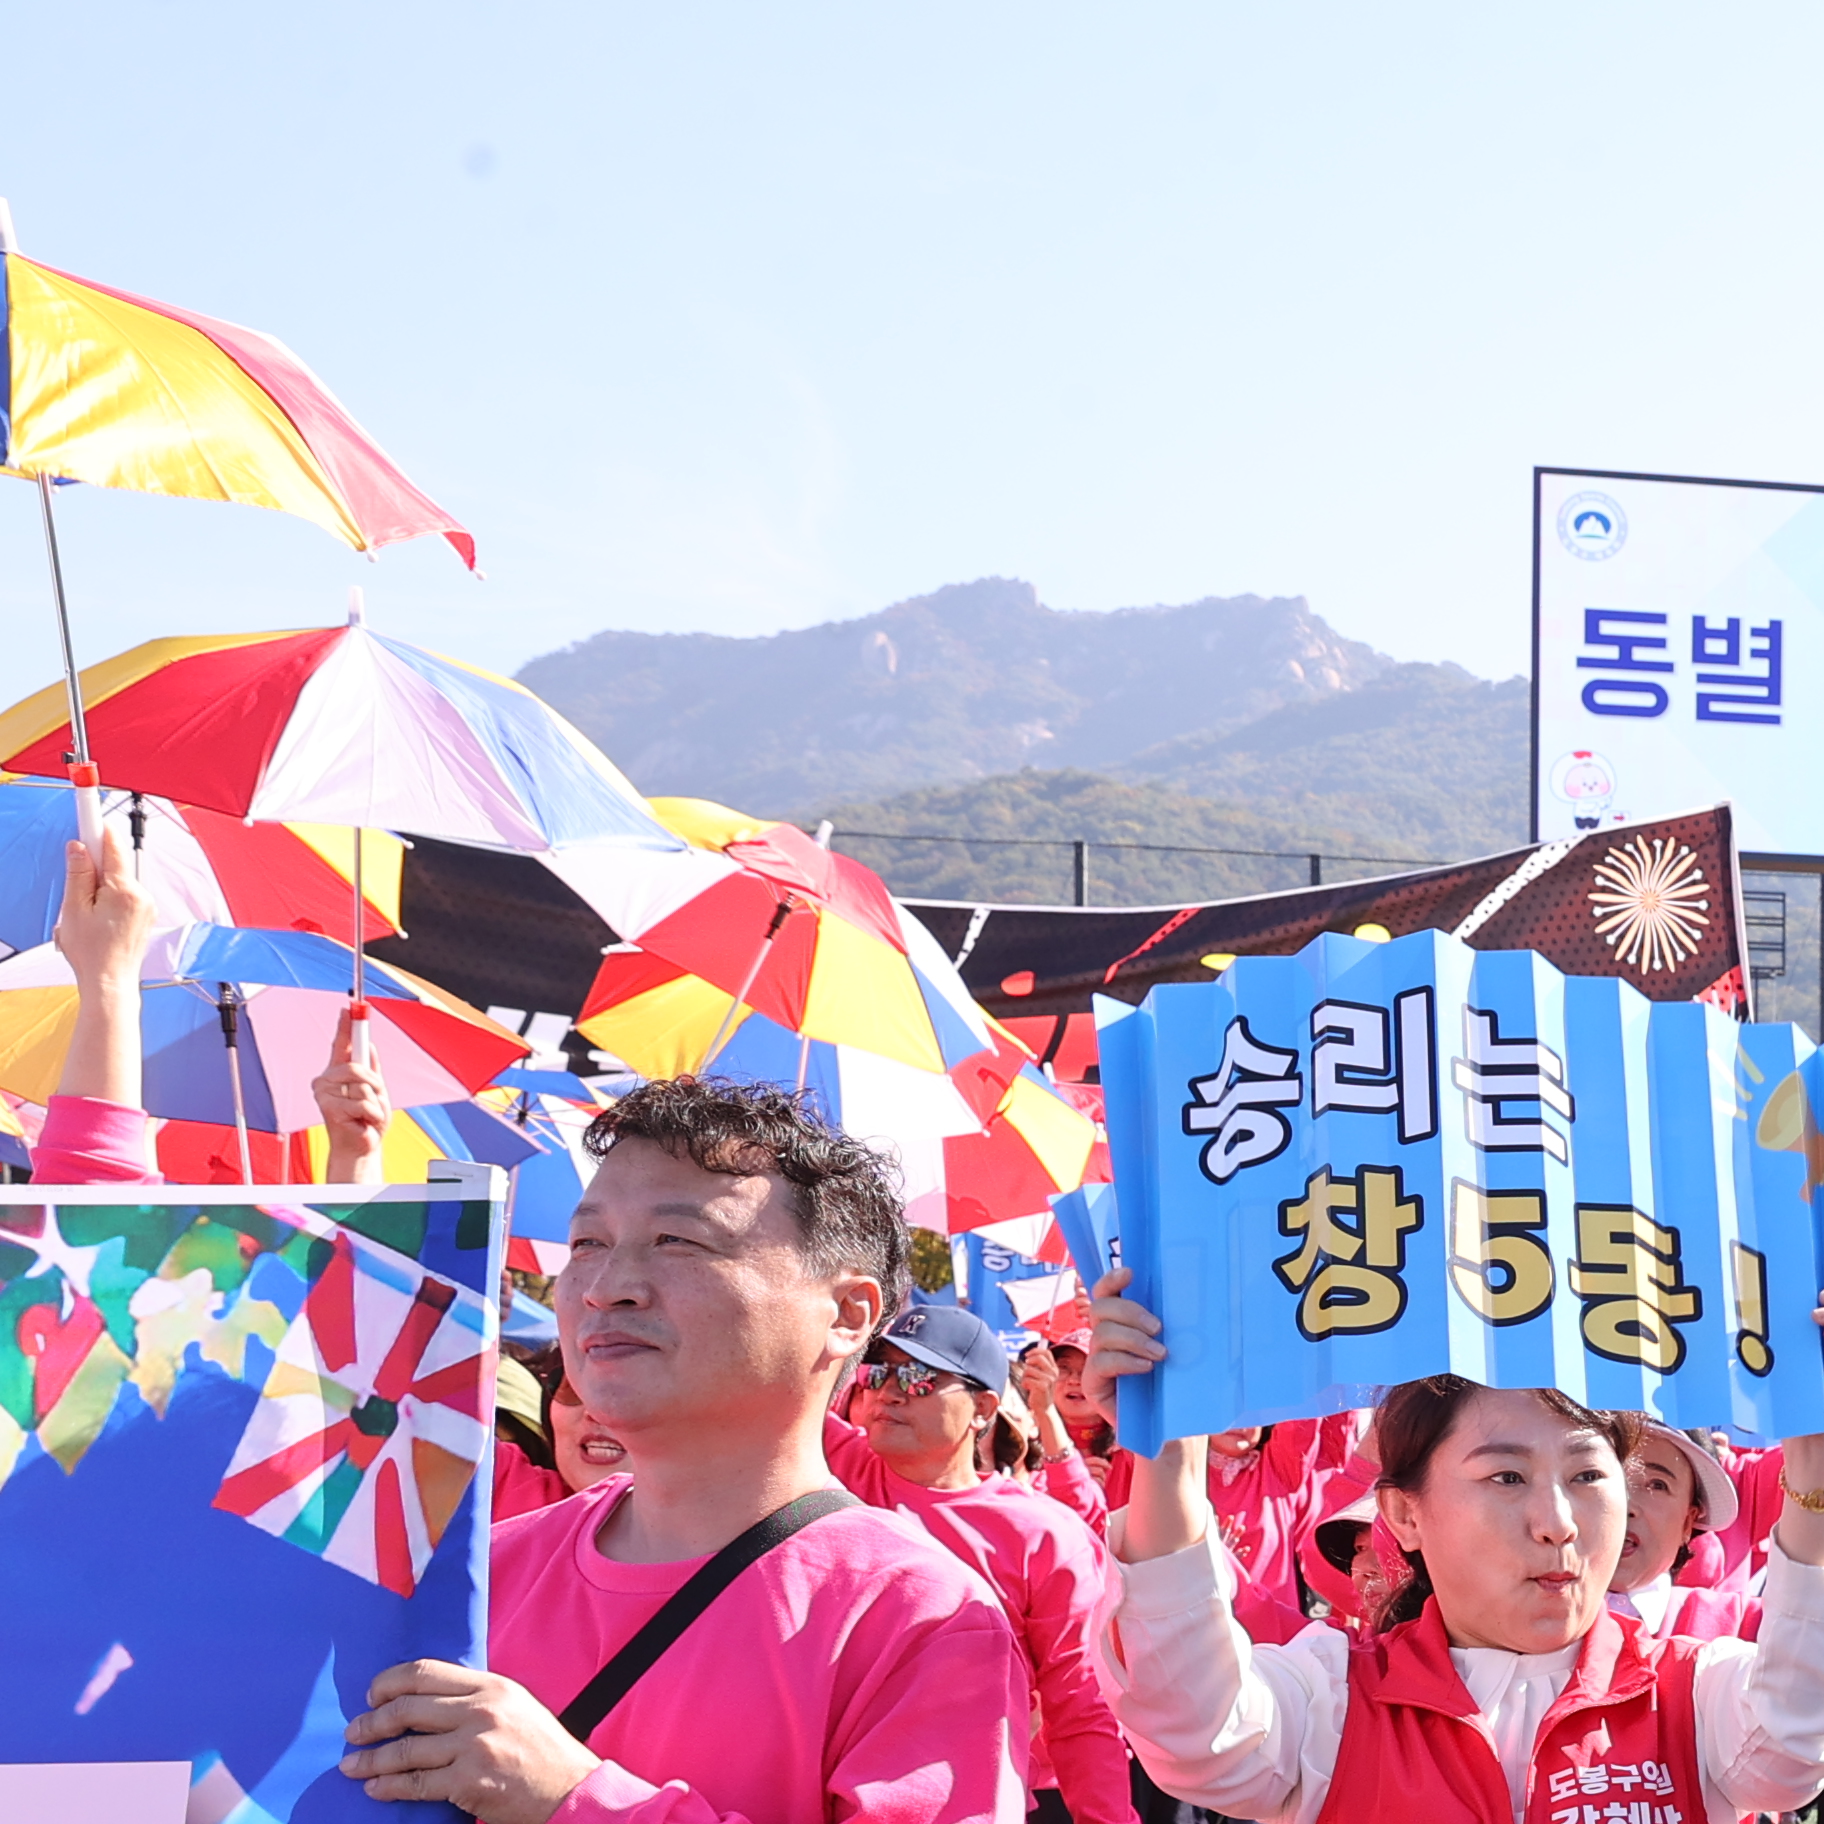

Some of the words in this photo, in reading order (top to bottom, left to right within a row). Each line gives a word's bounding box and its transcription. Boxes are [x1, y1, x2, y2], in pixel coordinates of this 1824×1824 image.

[1576, 608, 1782, 725] 동별
[1182, 985, 1575, 1185] 승리는
[1272, 1164, 1774, 1378] 창5동!
